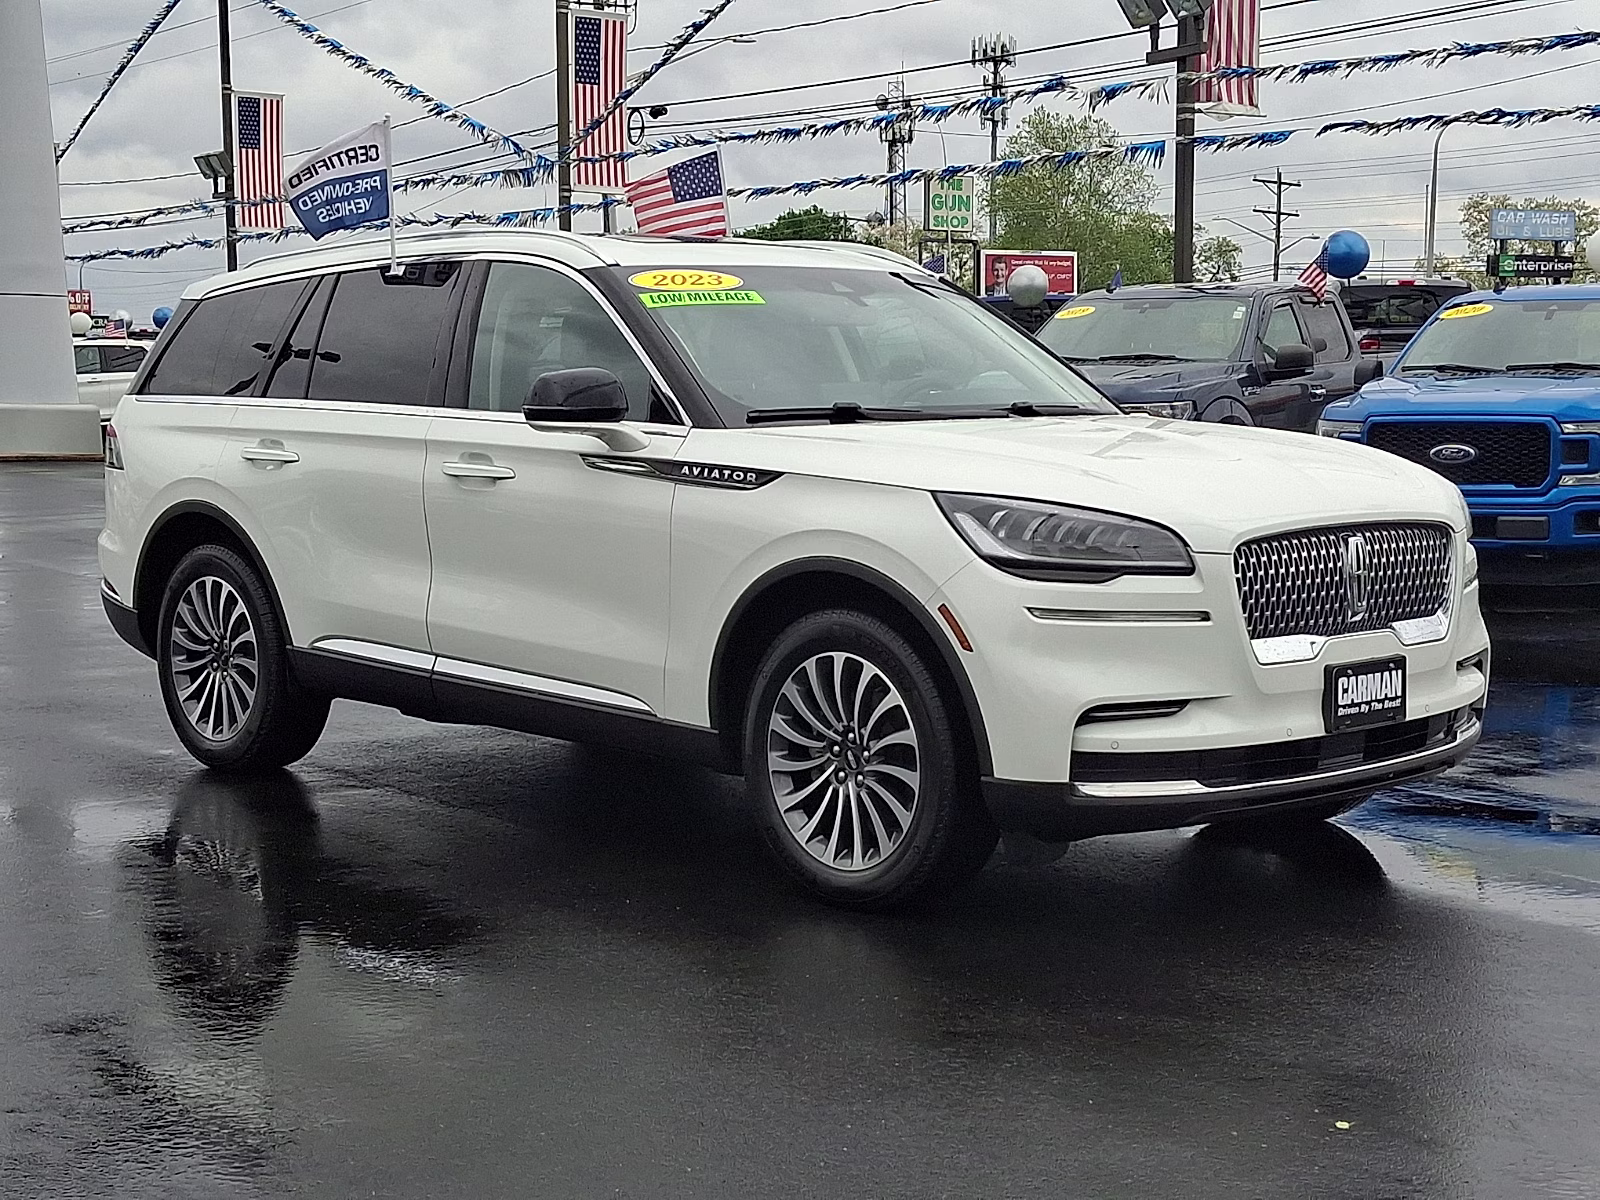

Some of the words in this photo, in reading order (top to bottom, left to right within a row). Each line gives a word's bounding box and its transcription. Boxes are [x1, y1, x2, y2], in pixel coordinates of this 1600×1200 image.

[940, 178, 963, 191] THE
[931, 193, 971, 212] GUN
[933, 215, 969, 228] SHOP
[1497, 211, 1525, 223] CAR
[1531, 212, 1568, 224] WASH
[1496, 225, 1516, 236] OIL
[1523, 226, 1532, 237] &
[1540, 227, 1571, 237] LUBE
[652, 274, 723, 286] 2023
[649, 292, 685, 304] LOW
[687, 291, 754, 302] MILEAGE
[1440, 448, 1464, 459] Ford
[680, 465, 757, 482] AVIATOR
[1337, 669, 1402, 705] CARMAN
[1337, 706, 1359, 716] Driven
[1360, 703, 1370, 713] By
[1371, 702, 1383, 711] The
[1384, 698, 1402, 709] Best!
